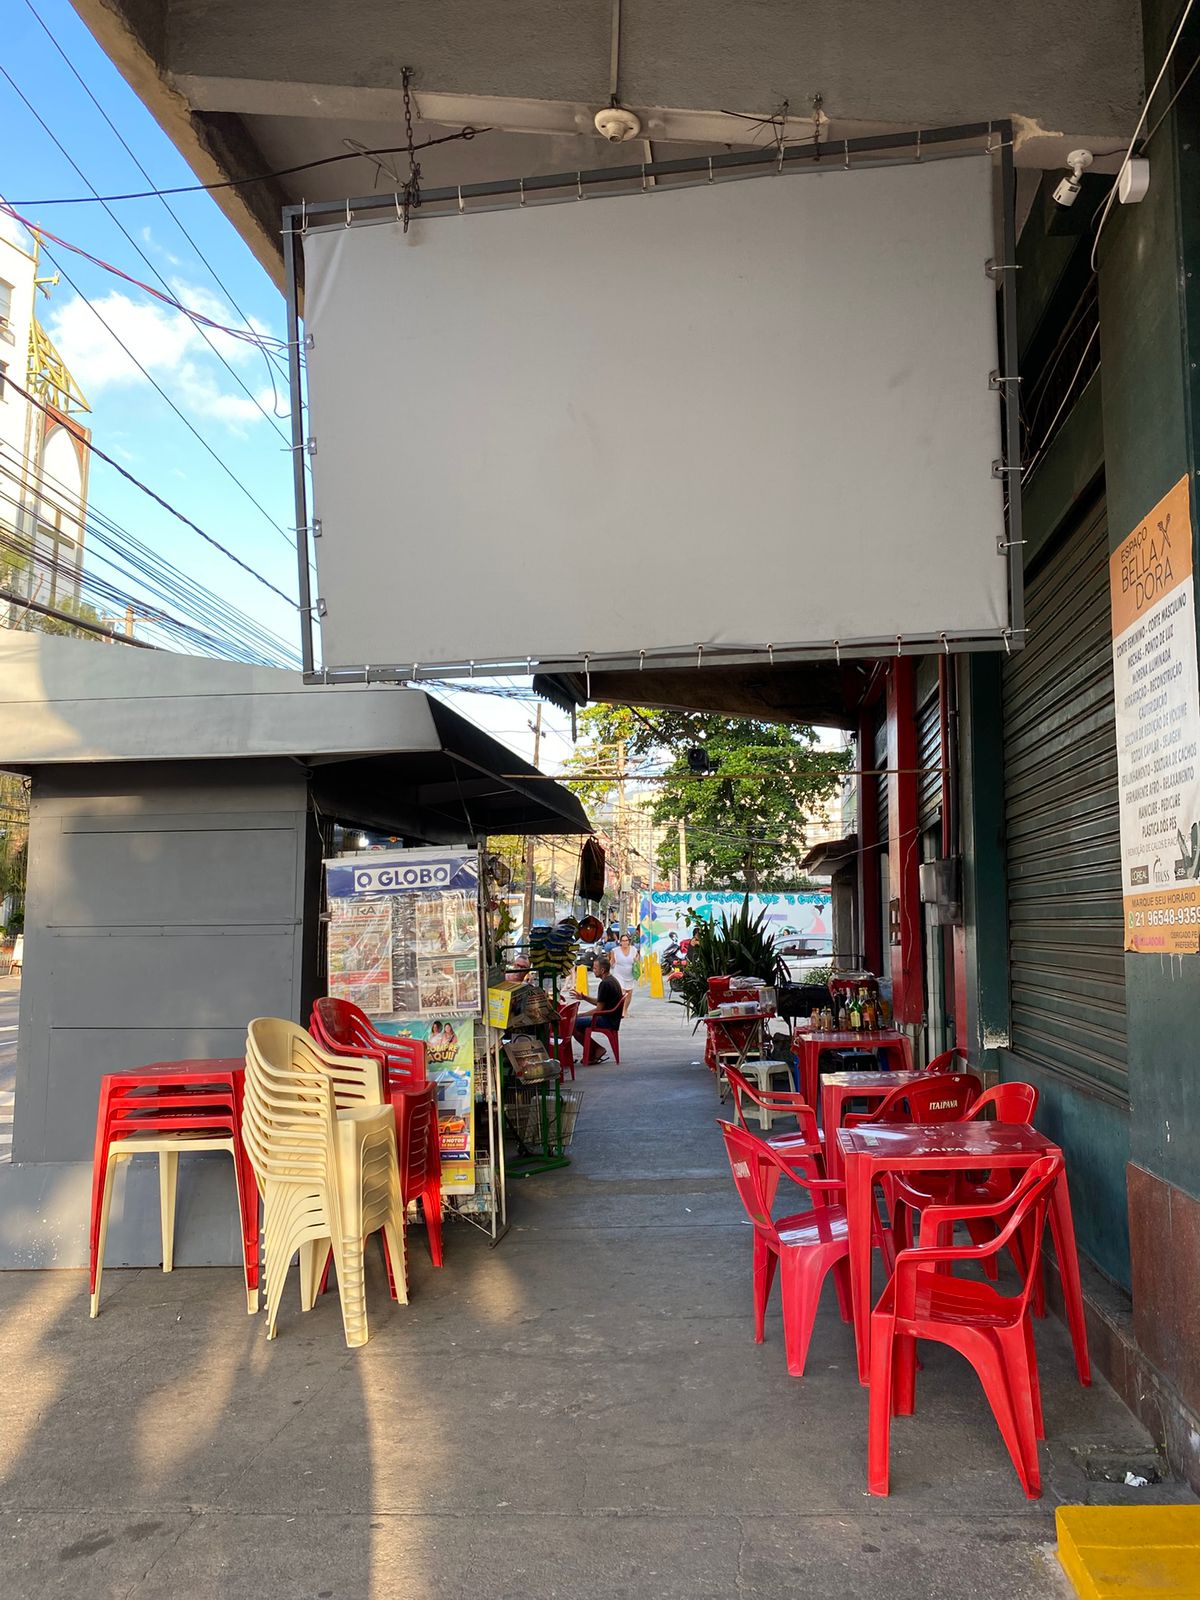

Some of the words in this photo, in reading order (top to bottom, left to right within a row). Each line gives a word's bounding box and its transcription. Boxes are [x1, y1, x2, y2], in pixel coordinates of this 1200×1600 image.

[1121, 527, 1147, 563] ESPAÇO
[1122, 539, 1158, 593] BELLA
[1136, 557, 1174, 610] DORA
[1147, 614, 1160, 633] CORTE
[1161, 593, 1186, 623] MASCULINO
[1159, 631, 1164, 645] DE
[357, 872, 372, 888] O
[378, 867, 448, 887] GLOBO
[1155, 895, 1165, 905] SEU
[1167, 890, 1195, 903] HORÁRIO
[1135, 910, 1144, 927] 21
[929, 1100, 958, 1111] ITAIPAVA
